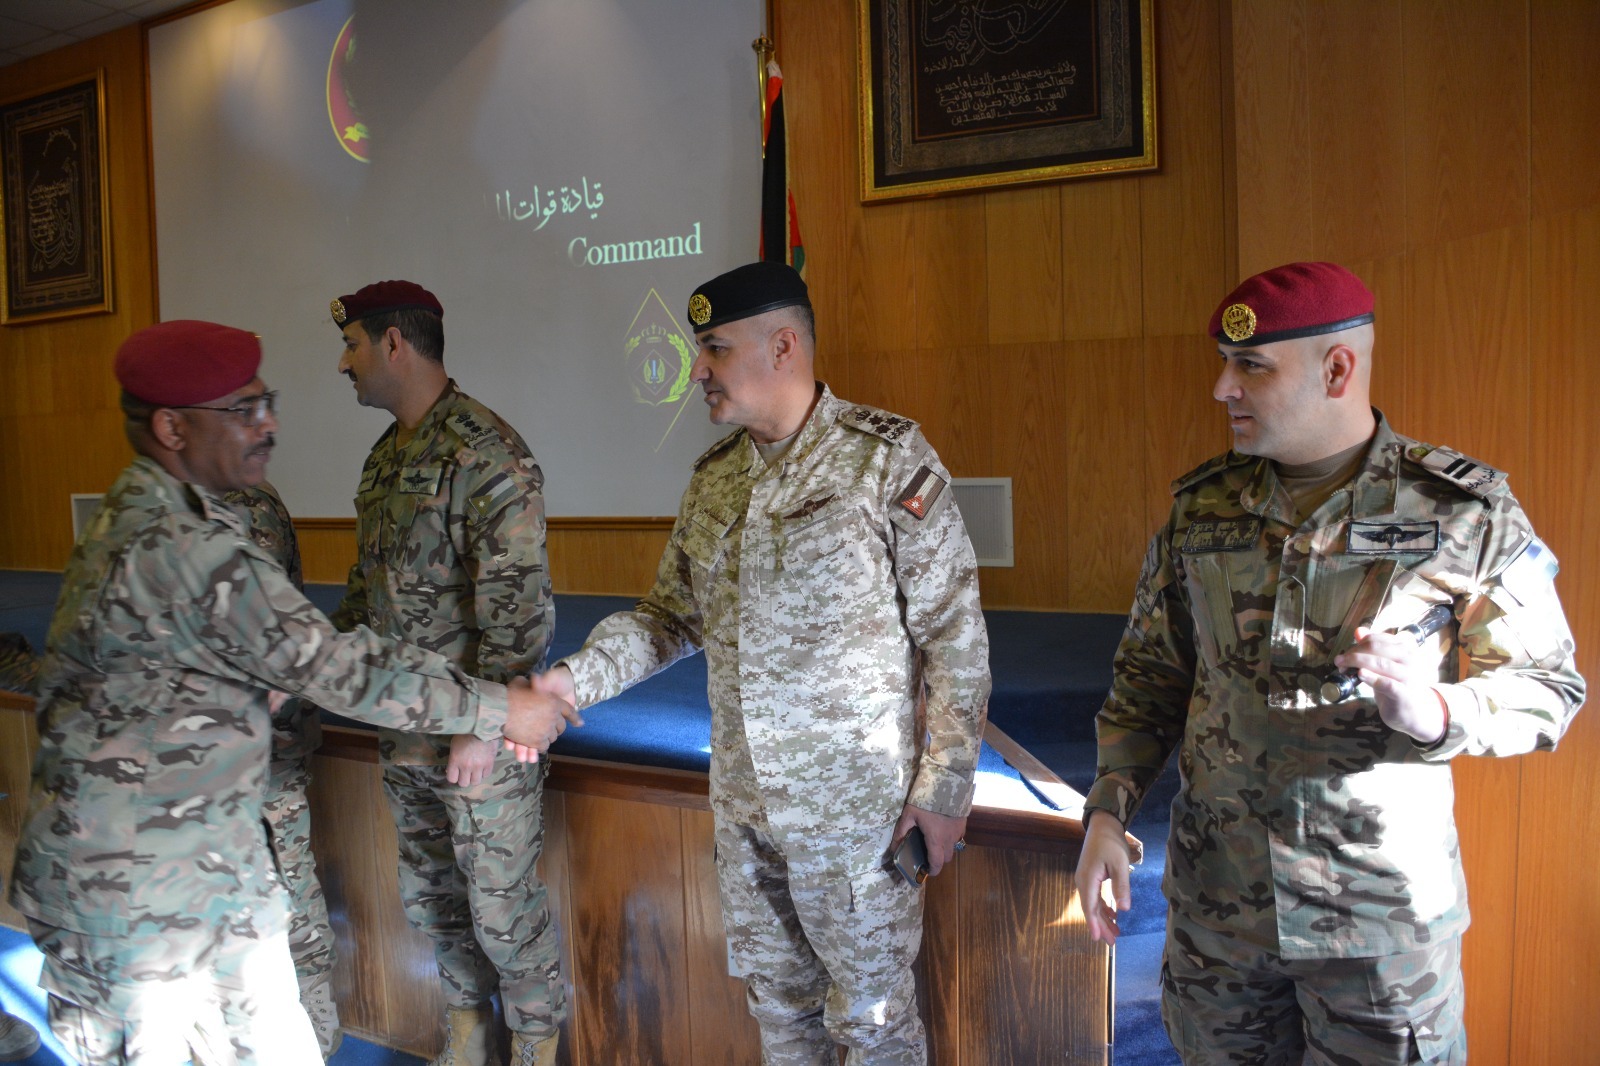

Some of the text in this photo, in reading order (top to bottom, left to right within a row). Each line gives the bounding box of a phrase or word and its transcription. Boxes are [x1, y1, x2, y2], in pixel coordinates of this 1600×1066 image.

[513, 185, 557, 232] قوات
[560, 176, 604, 220] قيادة
[567, 222, 703, 268] Command
